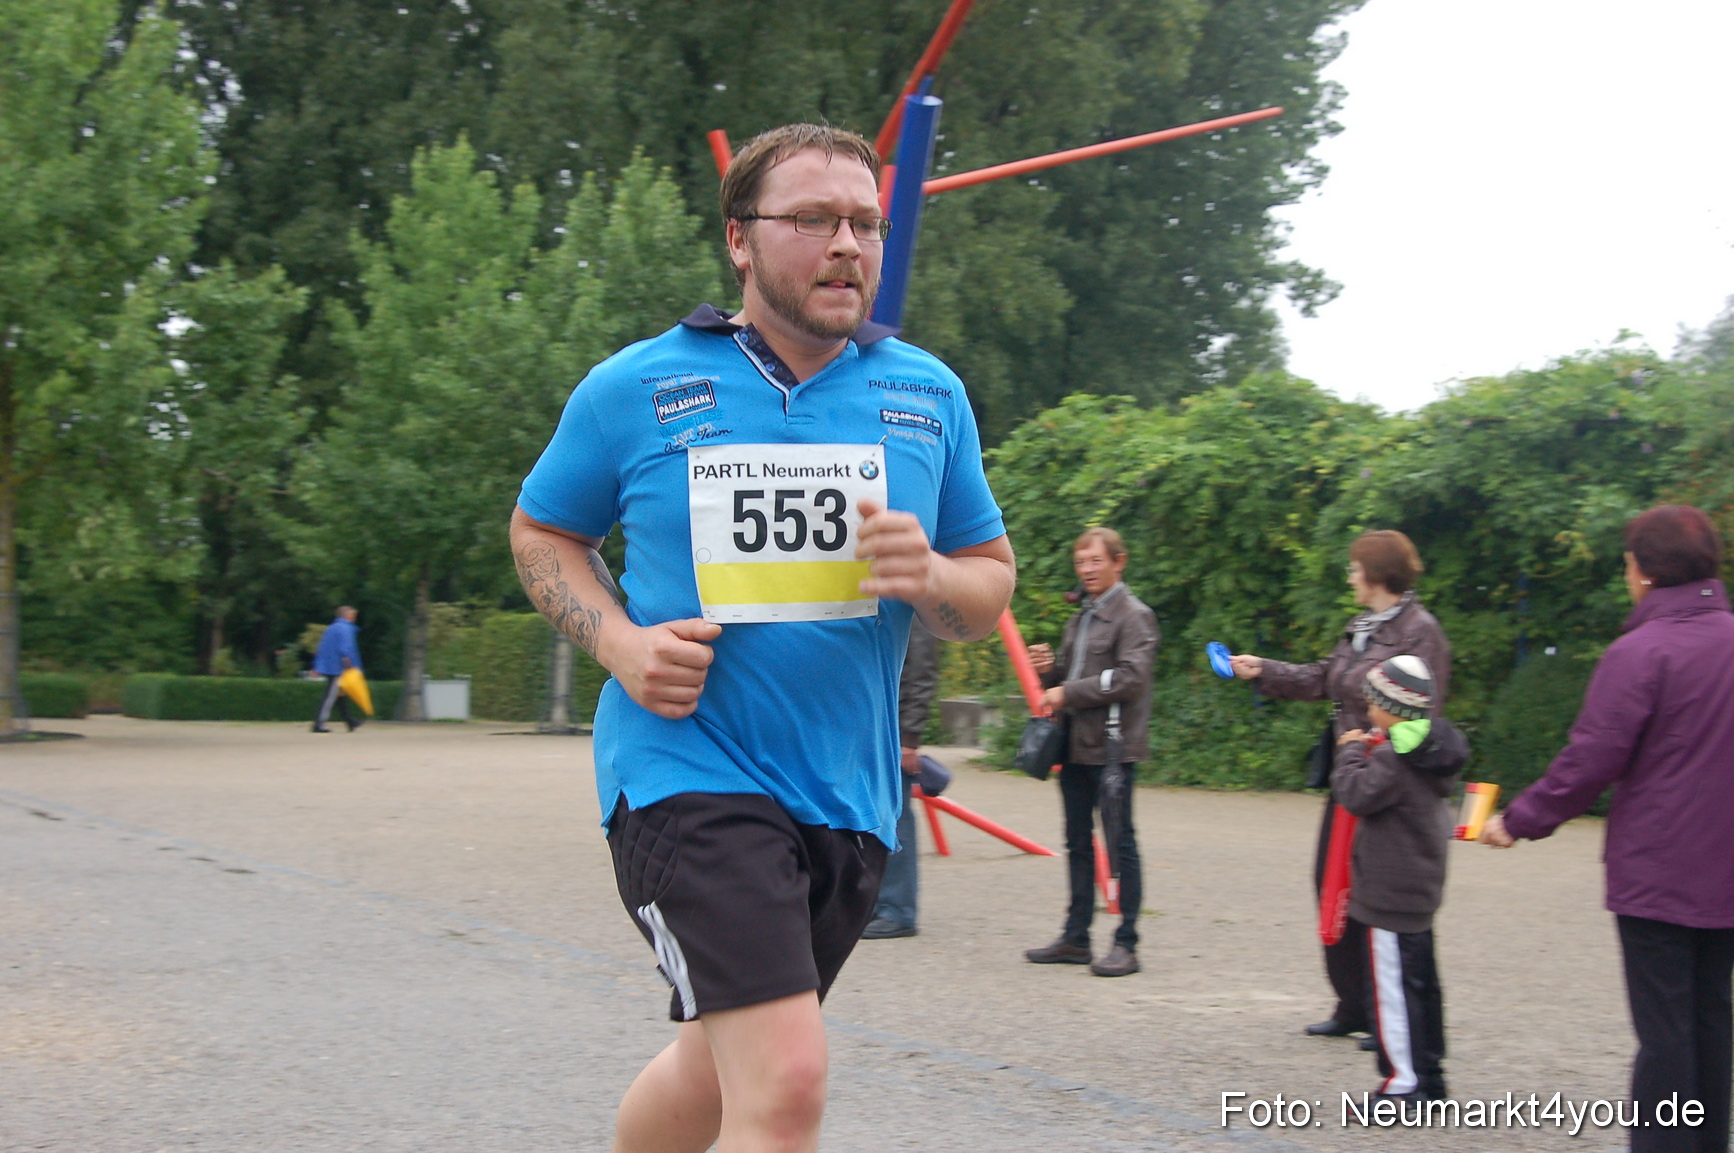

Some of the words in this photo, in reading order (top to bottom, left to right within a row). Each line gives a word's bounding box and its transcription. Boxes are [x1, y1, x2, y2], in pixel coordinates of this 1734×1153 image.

[868, 380, 952, 399] PAUL&SHARK
[659, 394, 711, 416] PAUL&SHARK
[693, 463, 758, 480] PARTL
[763, 463, 852, 478] Neumarkt
[732, 488, 848, 553] 553
